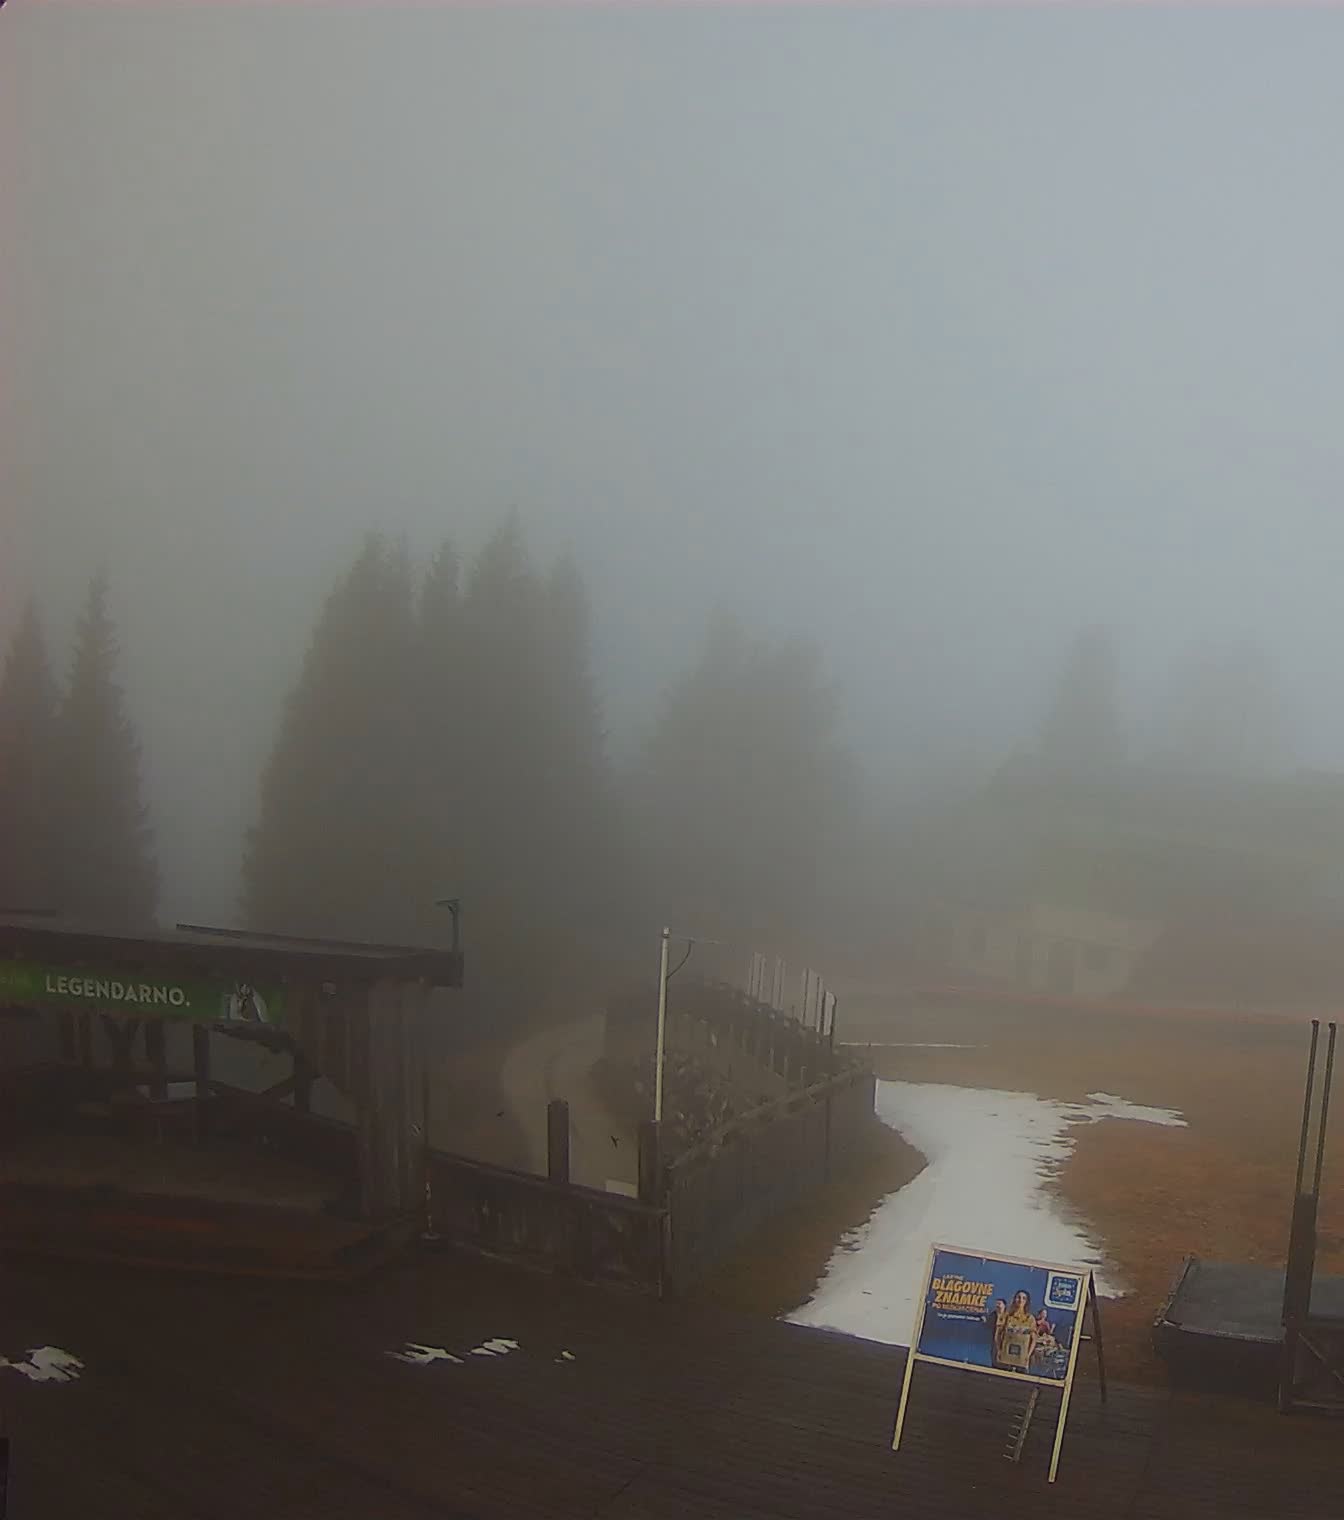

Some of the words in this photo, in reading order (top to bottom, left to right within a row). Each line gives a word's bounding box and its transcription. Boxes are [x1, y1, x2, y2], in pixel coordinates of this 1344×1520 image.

[45, 975, 191, 1007] LEGENDARNO.
[932, 1278, 994, 1296] BLAGOVNE
[935, 1290, 987, 1307] ZNAMKE
